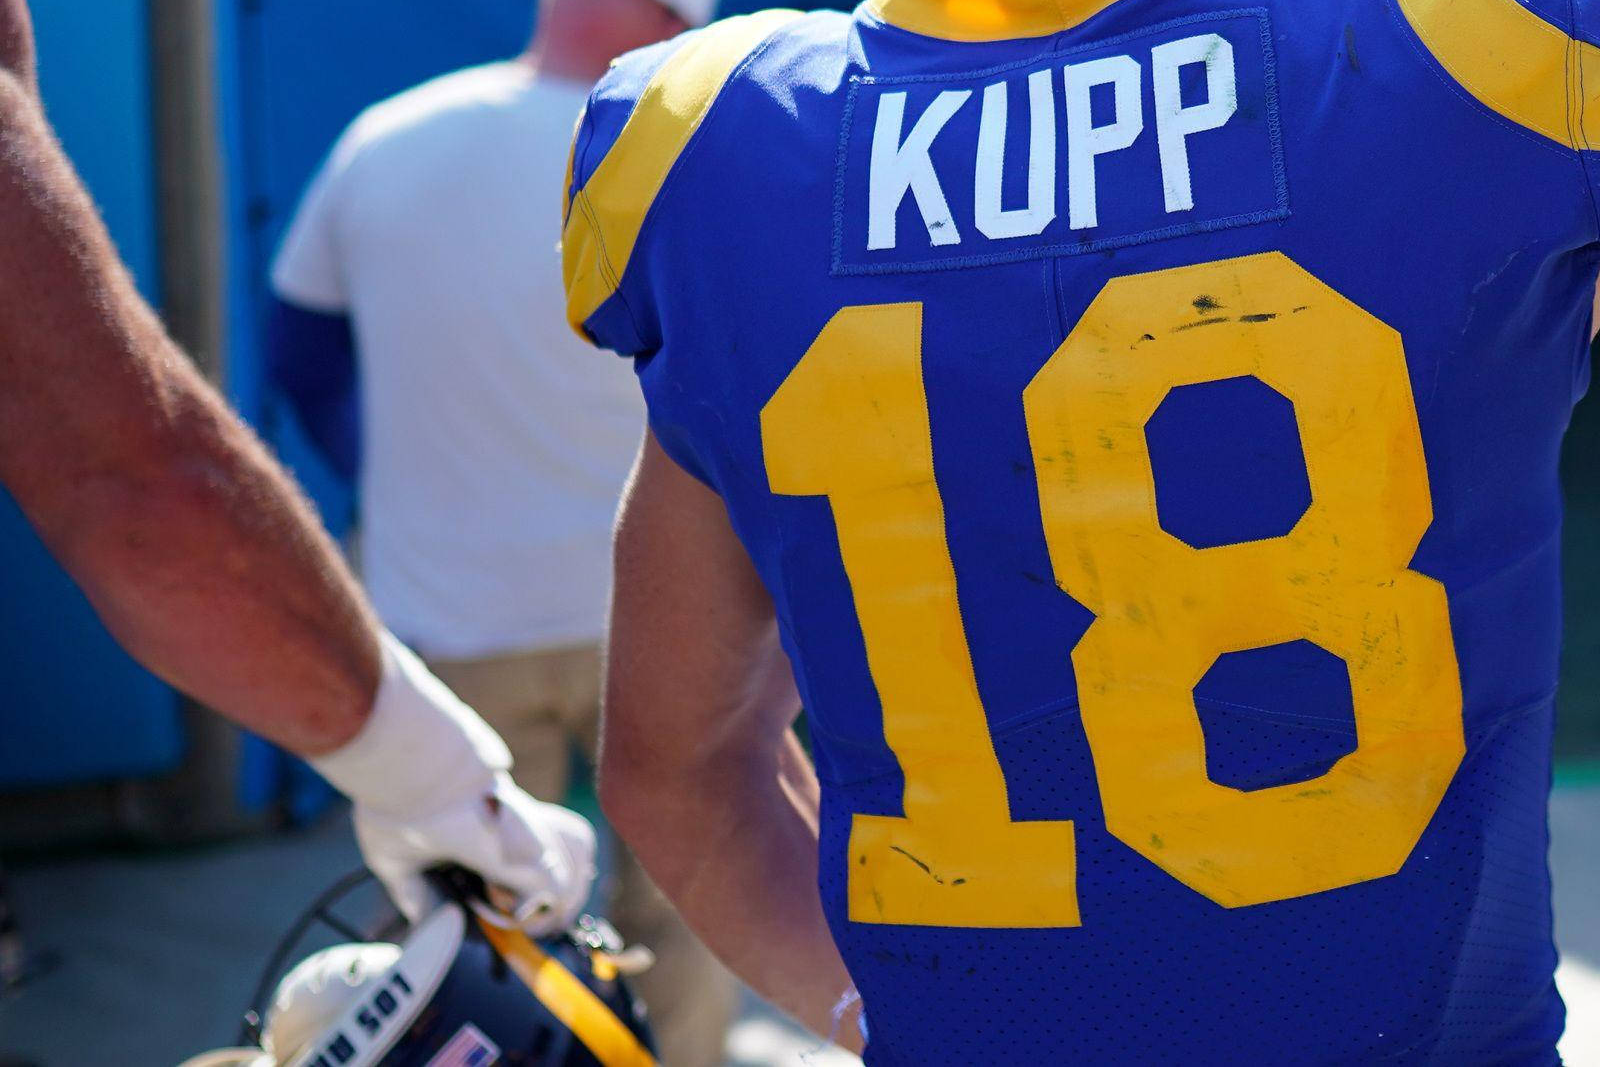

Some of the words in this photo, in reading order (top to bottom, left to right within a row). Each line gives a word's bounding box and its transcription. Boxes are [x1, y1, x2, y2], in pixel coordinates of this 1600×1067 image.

[866, 32, 1237, 251] KUPP
[760, 251, 1466, 929] 18
[357, 973, 412, 1036] LOS
